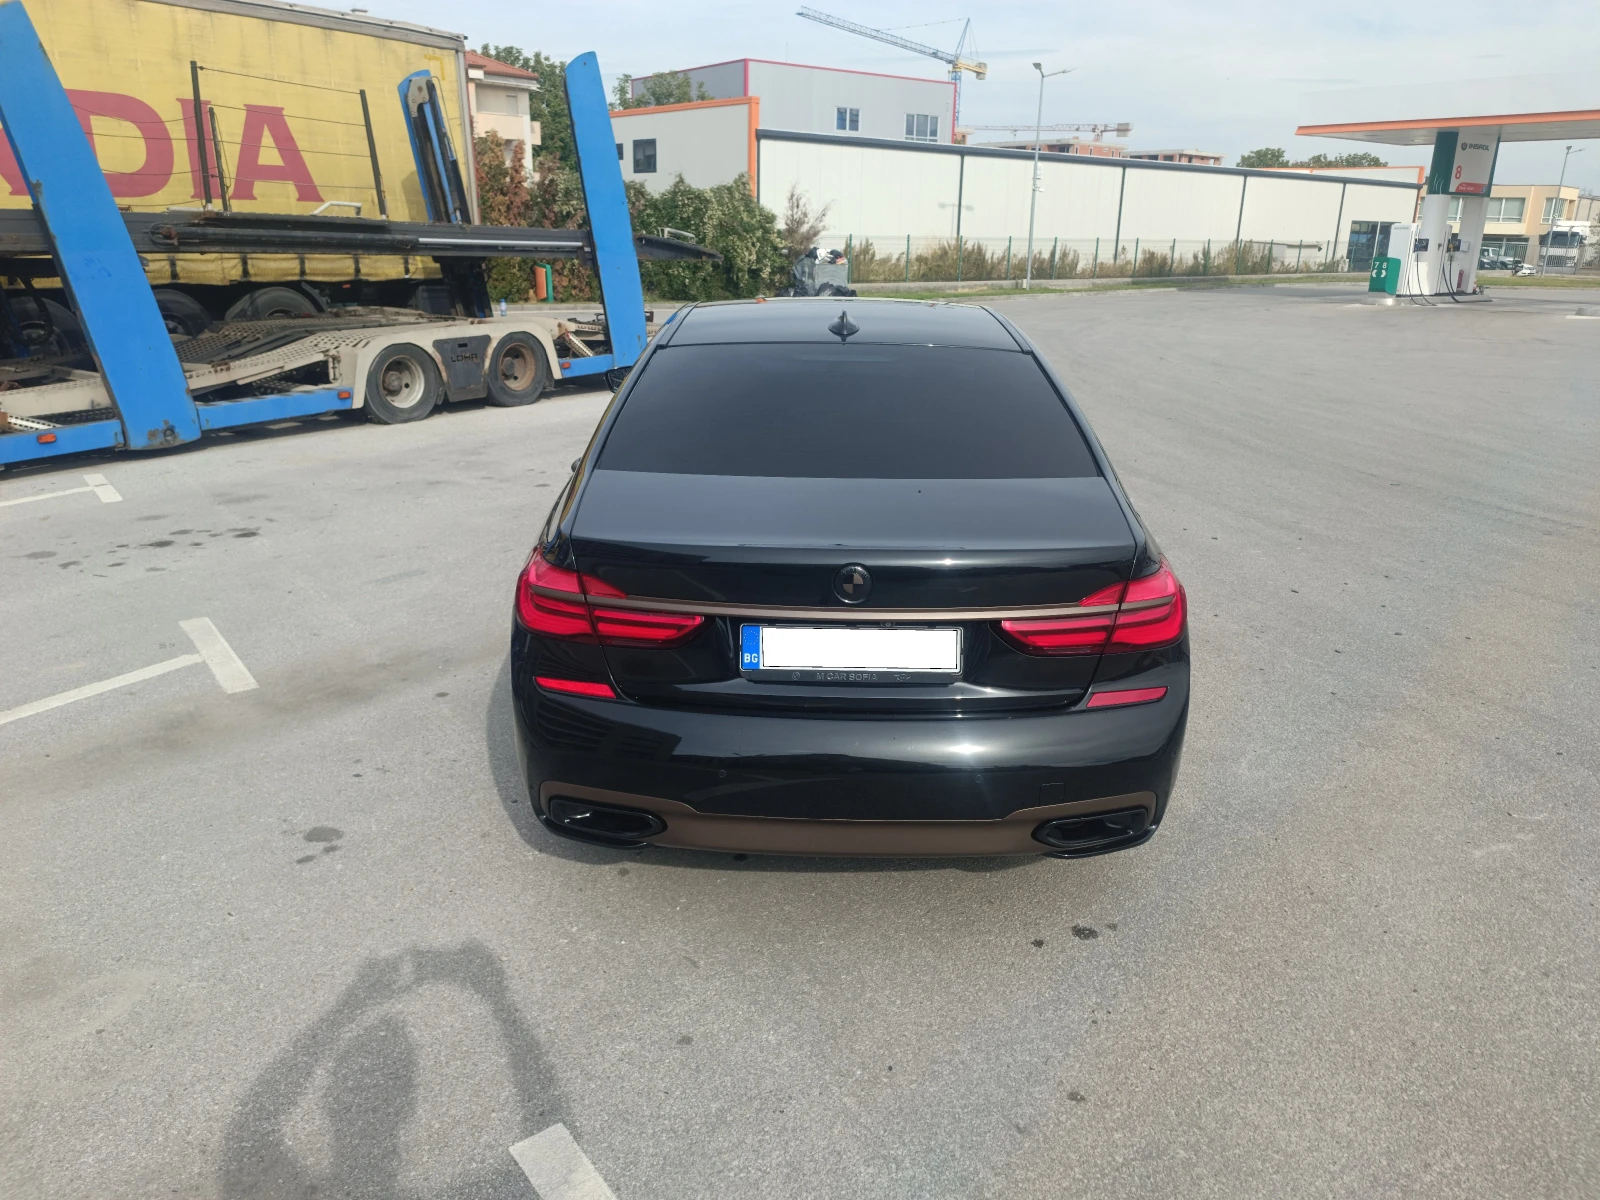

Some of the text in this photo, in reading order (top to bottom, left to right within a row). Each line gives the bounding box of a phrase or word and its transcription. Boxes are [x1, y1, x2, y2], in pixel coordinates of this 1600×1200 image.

[1455, 165, 1463, 180] 8
[1374, 261, 1380, 269] 7
[450, 353, 479, 363] LOHR
[744, 653, 759, 664] BG
[816, 672, 878, 682] M CAR SOFIA
